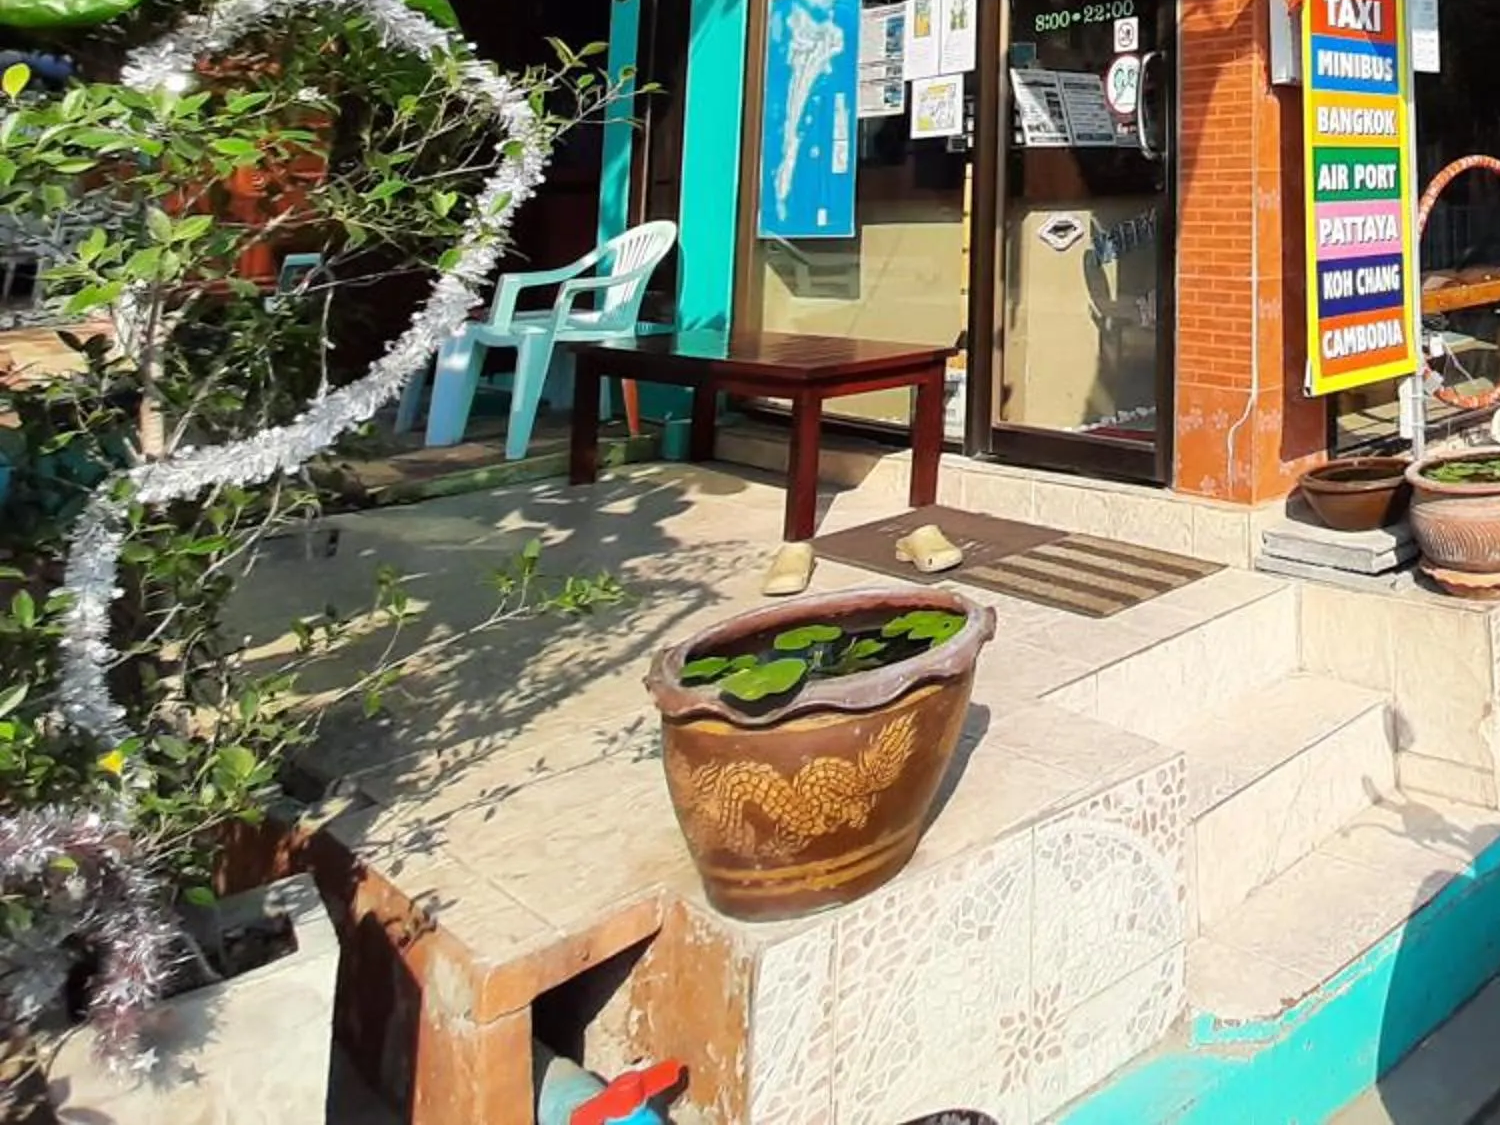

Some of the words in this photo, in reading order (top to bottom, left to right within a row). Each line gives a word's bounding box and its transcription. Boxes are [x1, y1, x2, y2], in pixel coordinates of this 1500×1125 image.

[1317, 49, 1394, 82] MINIBUS
[1317, 106, 1398, 135] BANGKOK
[1318, 164, 1349, 191] AIR
[1354, 162, 1398, 190] PORT
[1319, 213, 1399, 246] PATTAYA
[1323, 270, 1352, 300] KOH
[1356, 264, 1401, 294] CHANG
[1322, 319, 1404, 359] CAMBODIA
